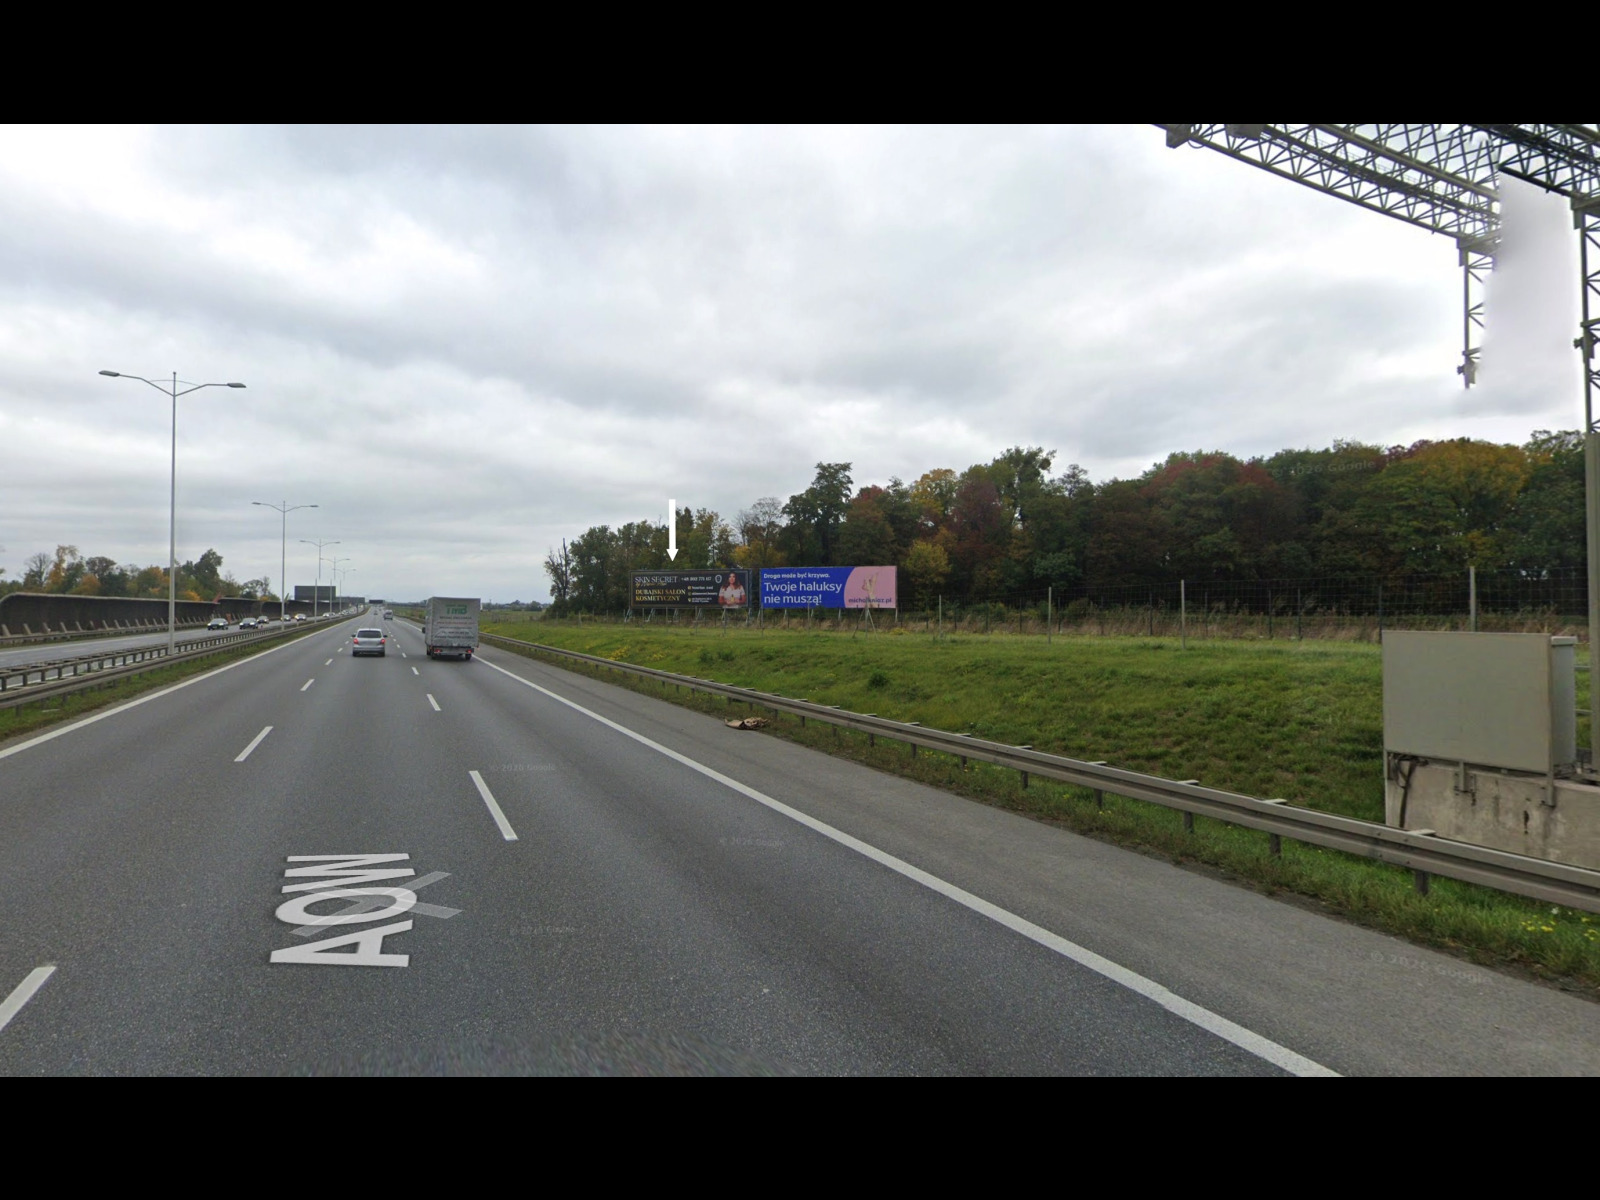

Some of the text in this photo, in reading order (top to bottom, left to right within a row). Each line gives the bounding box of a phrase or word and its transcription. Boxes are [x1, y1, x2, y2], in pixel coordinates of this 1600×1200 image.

[763, 581, 842, 593] Twoje haluksy
[763, 594, 822, 606] nie muszą!
